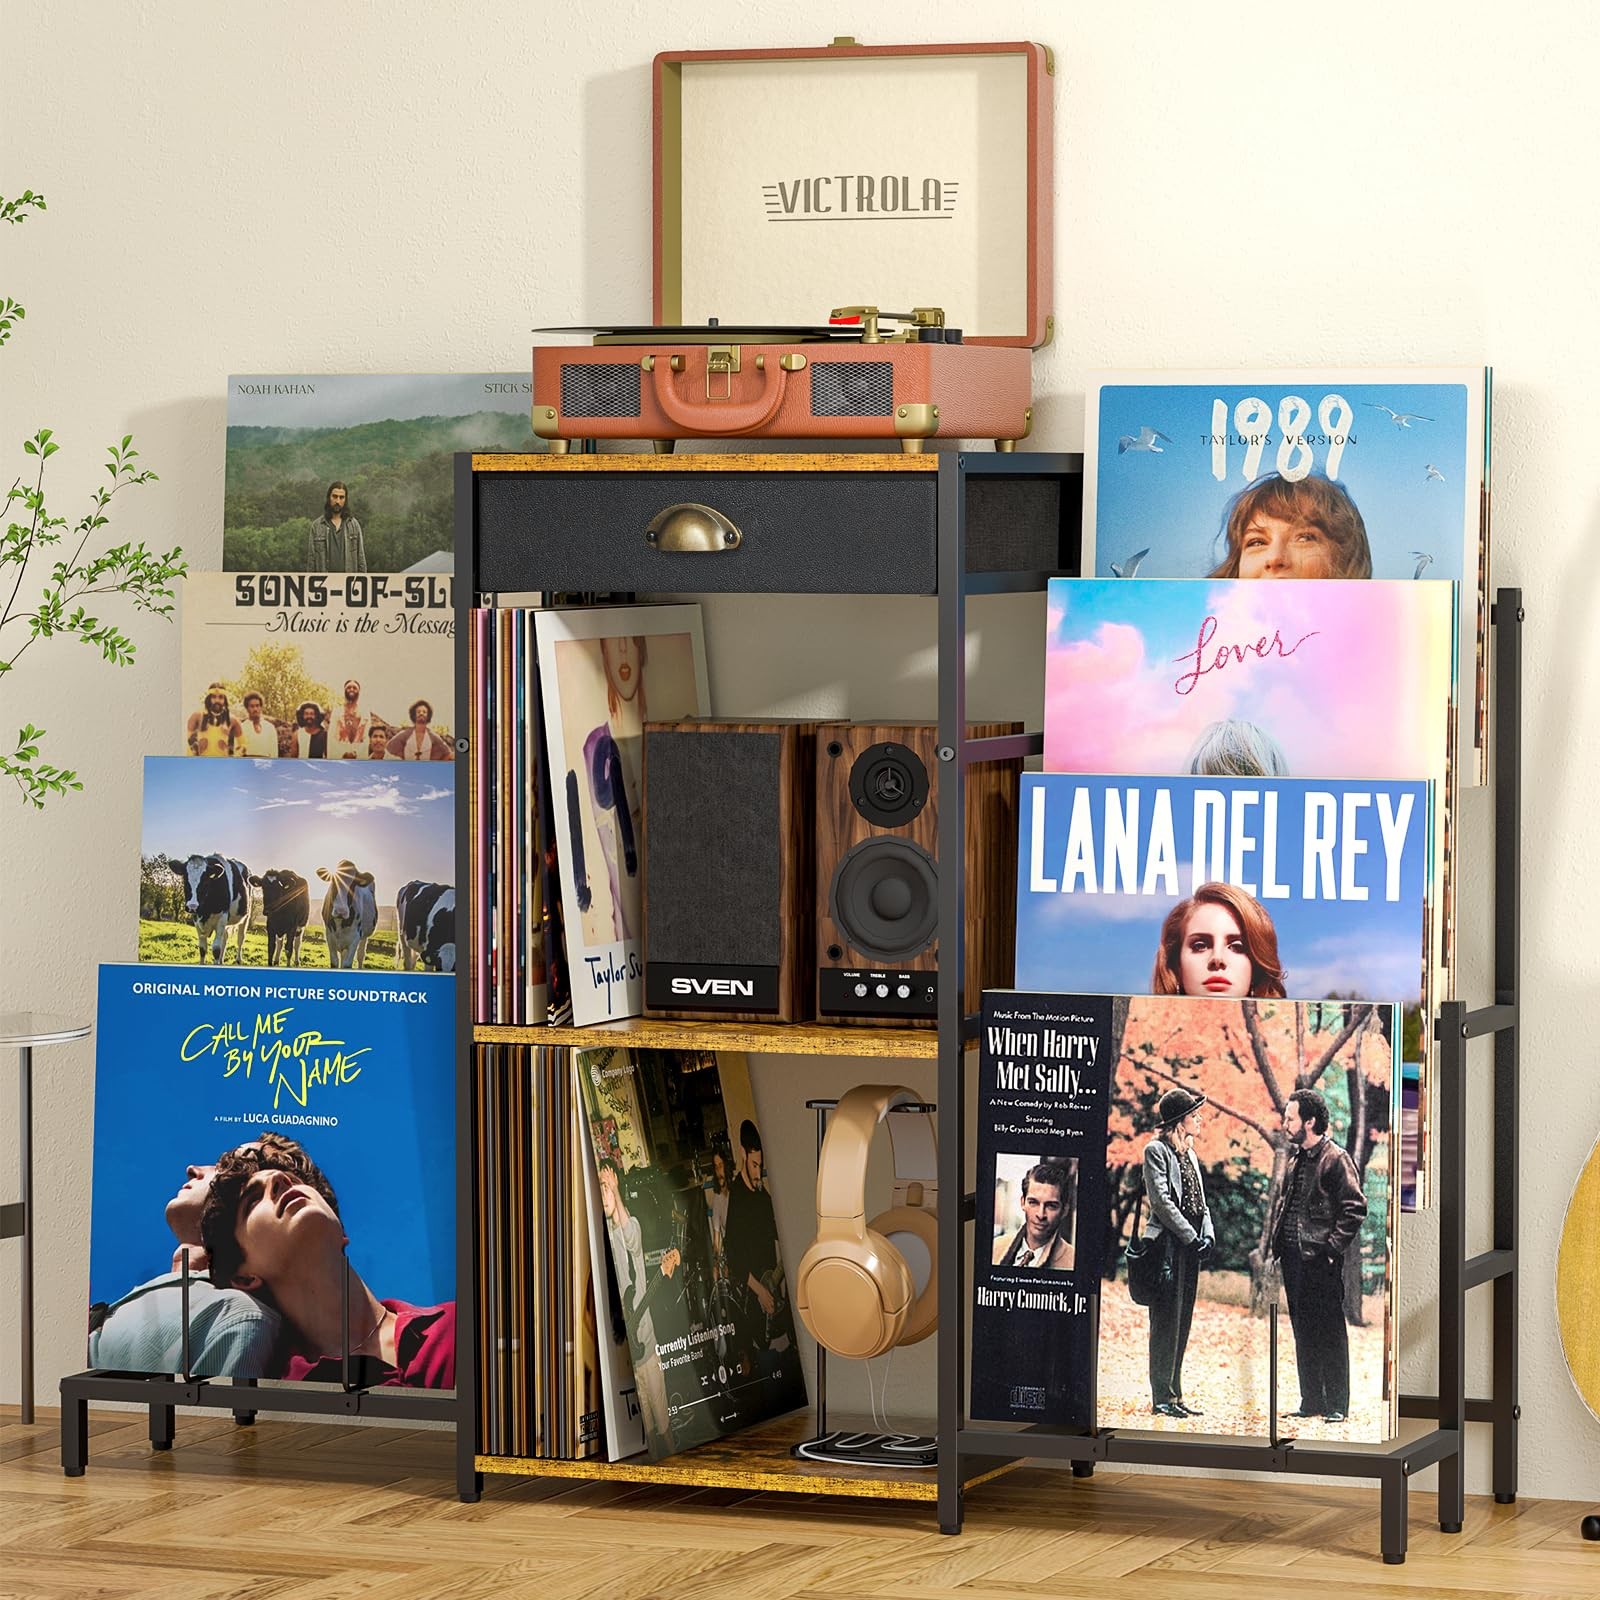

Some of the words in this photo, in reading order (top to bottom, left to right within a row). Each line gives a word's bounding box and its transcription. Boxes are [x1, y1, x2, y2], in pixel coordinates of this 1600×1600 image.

[778, 175, 942, 213] VICTROLA
[238, 384, 271, 395] NOAH
[274, 384, 316, 395] KAHAN
[484, 383, 519, 394] STICK
[1200, 433, 1273, 447] TAYLOR'S
[1285, 434, 1358, 446] VERSION
[1210, 393, 1354, 483] 1989
[234, 574, 456, 609] SONS-OF-SL
[264, 611, 331, 634] Music
[335, 611, 350, 633] is
[352, 611, 380, 633] the
[1171, 615, 1321, 696] Lover
[1029, 786, 1180, 896] LANA
[1191, 789, 1291, 899] DEL
[1302, 790, 1416, 902] REY
[132, 982, 200, 996] ORIGINAL
[203, 984, 261, 998] MOTION
[265, 986, 325, 1000] PICTURE
[328, 988, 428, 1004] SOUNDTRACK
[584, 951, 626, 1016] Taylor
[671, 977, 754, 997] SVEN
[993, 1010, 1013, 1019] Music
[1014, 1011, 1032, 1020] From
[1032, 1012, 1044, 1020] The
[1045, 1013, 1070, 1022] Motion
[1070, 1014, 1094, 1023] Picture
[180, 1021, 250, 1062] CALL
[252, 1007, 295, 1049] ME
[987, 1026, 1038, 1058] When
[1043, 1029, 1100, 1066] Harry
[260, 1031, 345, 1084] YOUR
[273, 1047, 373, 1109] NAME
[601, 1067, 623, 1078] Company
[623, 1064, 635, 1075] Logo
[996, 1061, 1030, 1091] Met
[1014, 1099, 1042, 1109] Comedy
[1043, 1101, 1053, 1110] by
[1054, 1101, 1068, 1109] Rob
[243, 1113, 270, 1124] LUCA
[271, 1114, 338, 1127] GUADAGNINO
[994, 1123, 1008, 1133] Billy
[1009, 1124, 1034, 1134] Crystal
[1034, 1126, 1048, 1134] and
[1049, 1128, 1065, 1137] Meg
[1066, 1128, 1083, 1137] Ryan
[1025, 1115, 1054, 1126] Starring
[977, 1286, 1016, 1312] Harry
[1017, 1288, 1072, 1314] Connick,
[1074, 1293, 1087, 1315] Jr.
[655, 1335, 687, 1357] Currently
[687, 1326, 719, 1347] Listening
[718, 1322, 736, 1336] Song
[658, 1360, 671, 1372] Your
[670, 1353, 691, 1368] Favorite
[690, 1349, 703, 1360] Band
[667, 1405, 678, 1417] 2:53
